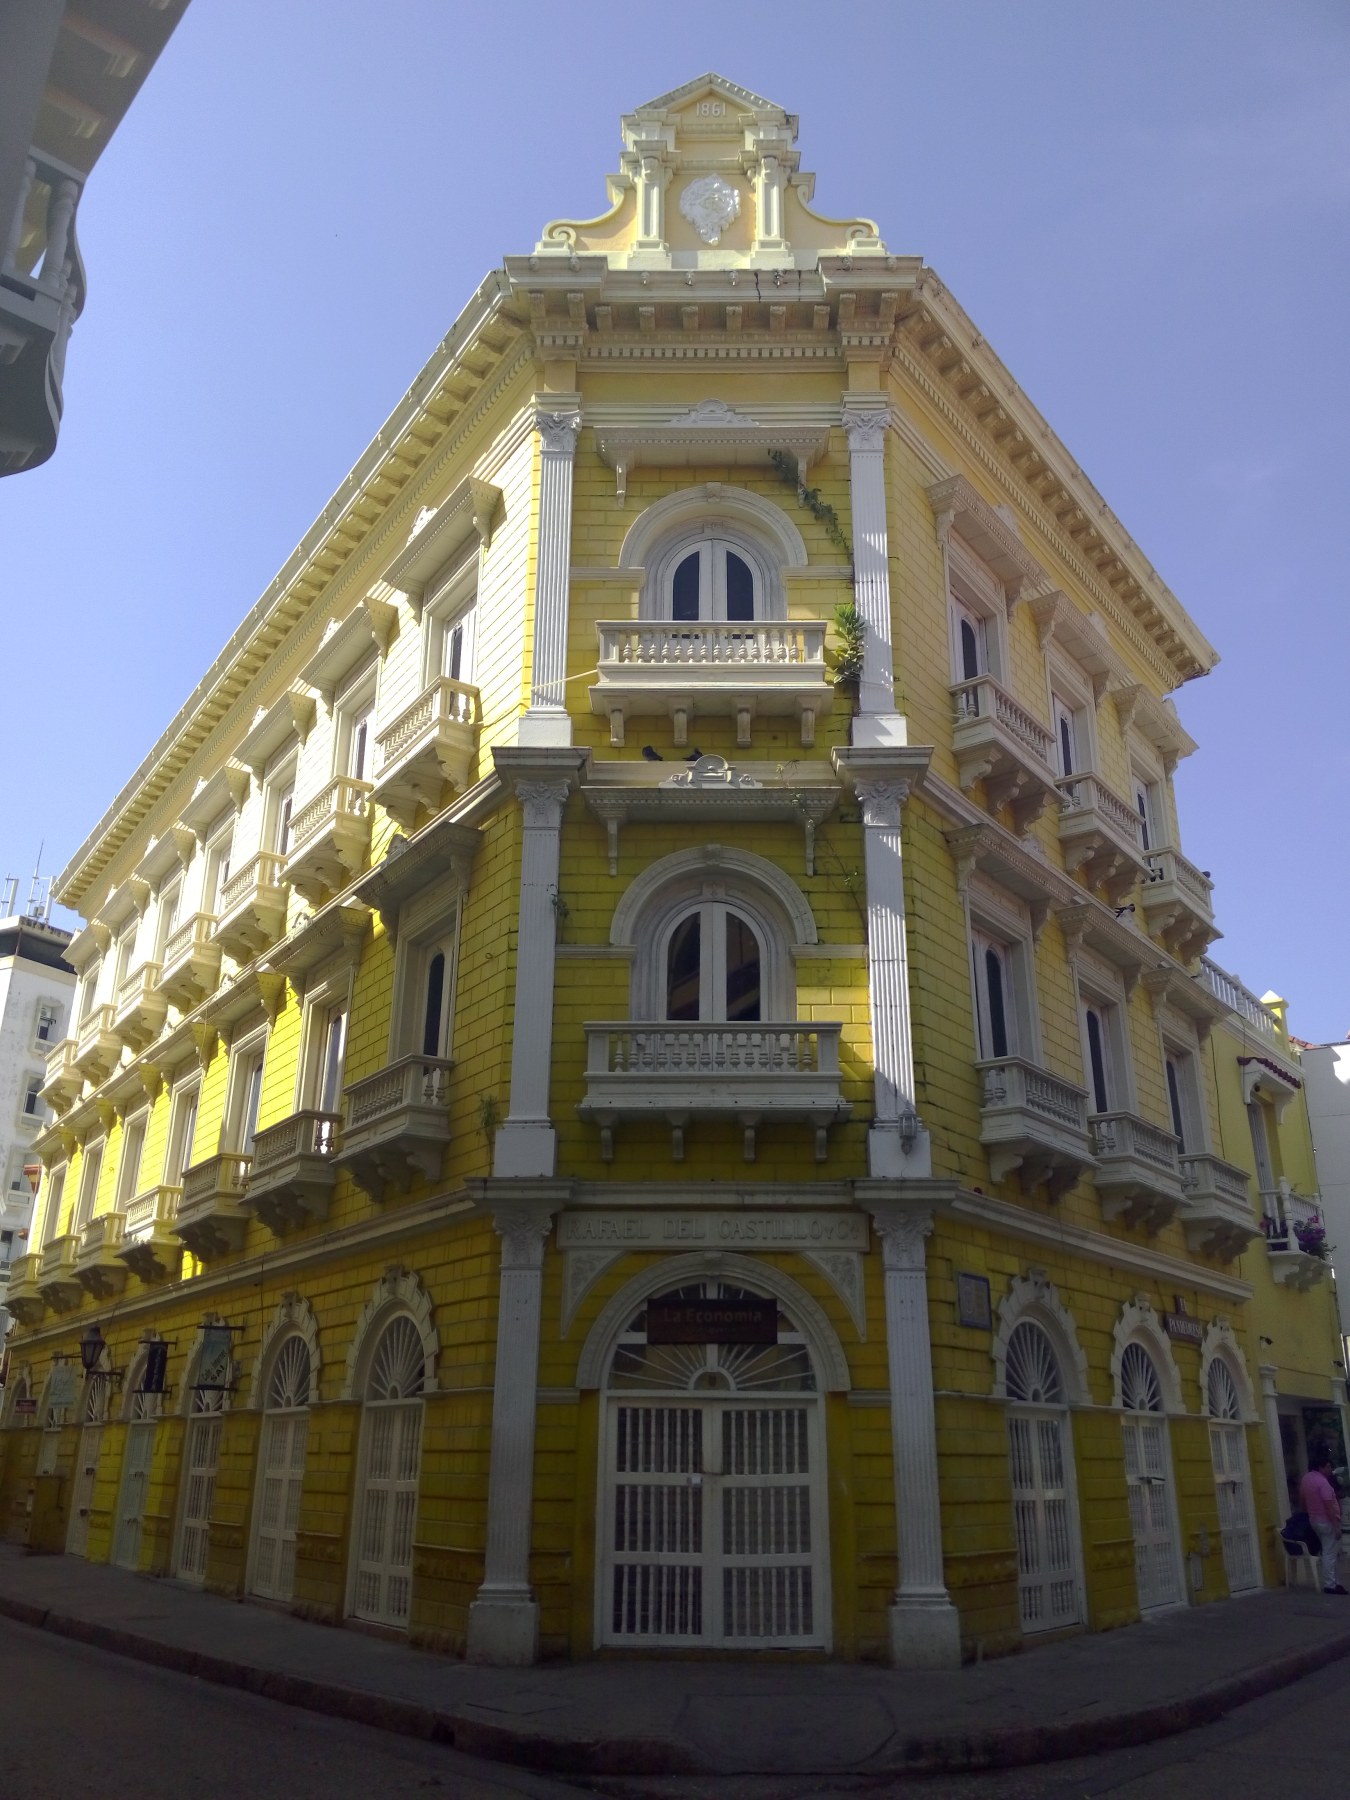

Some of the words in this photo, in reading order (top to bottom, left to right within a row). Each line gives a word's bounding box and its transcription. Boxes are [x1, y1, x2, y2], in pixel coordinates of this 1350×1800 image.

[696, 102, 726, 117] 1861
[566, 1219, 649, 1240] RAFAEL
[663, 1219, 705, 1240] DEL
[719, 1219, 822, 1240] CASTILLO
[663, 1307, 681, 1322] La
